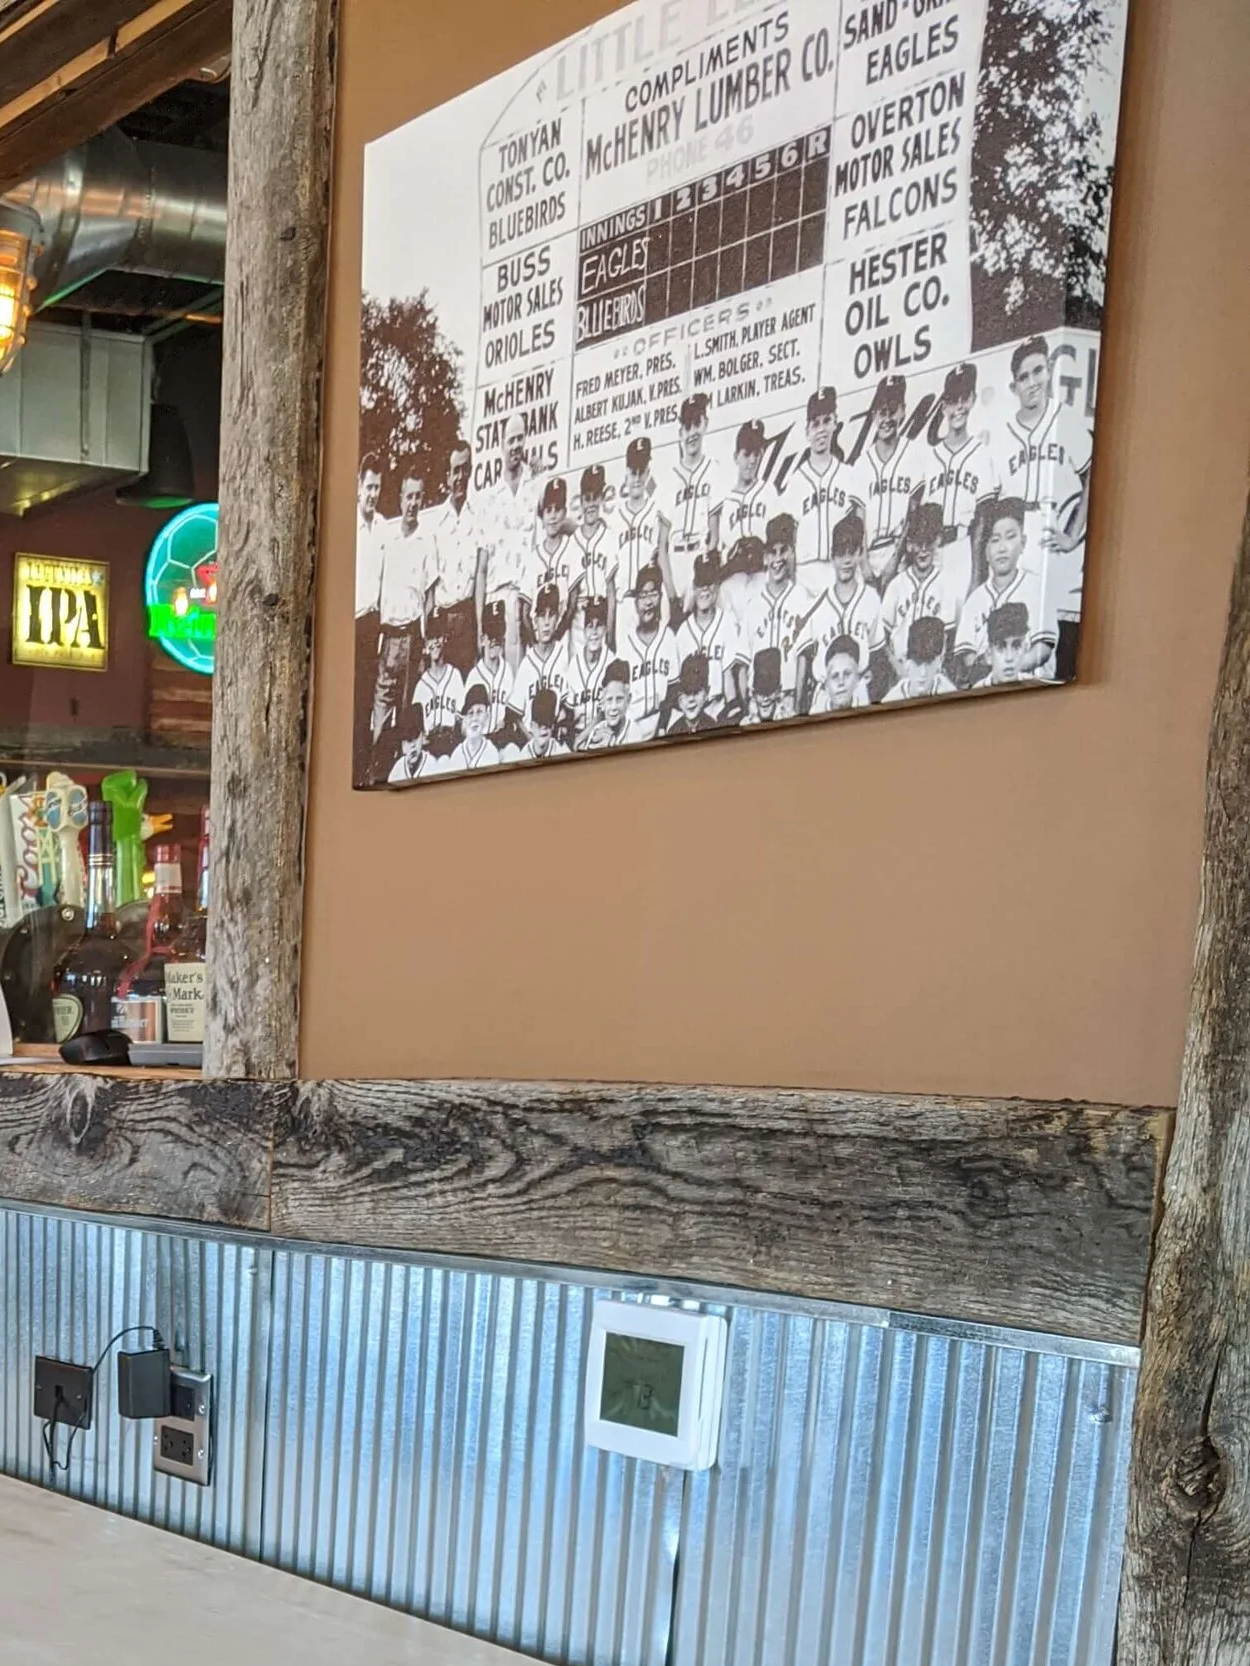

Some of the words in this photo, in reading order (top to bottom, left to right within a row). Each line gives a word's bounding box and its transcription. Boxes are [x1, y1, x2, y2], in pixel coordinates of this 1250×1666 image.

[843, 0, 898, 50] SAND
[866, 14, 959, 86] EAGLES
[625, 11, 789, 113] COMPLIMENTS
[585, 96, 686, 181] McHENRY
[695, 48, 792, 133] LUMBER
[801, 27, 835, 82] CO.
[851, 72, 967, 149] OVERTON
[499, 117, 562, 174] TONYAN
[646, 136, 709, 187] PHONE
[714, 115, 755, 152] 46
[834, 144, 894, 198] MOTOR
[901, 116, 962, 173] SALES
[486, 165, 536, 213] CONST.
[543, 151, 570, 187] CO.
[581, 203, 646, 248] INNINGS
[653, 198, 662, 219] 1
[676, 188, 691, 211] 2
[702, 176, 717, 201] 3
[726, 165, 745, 188] 4
[755, 154, 773, 178] 5
[781, 142, 798, 167] 6
[806, 131, 828, 158] R
[843, 167, 958, 241] FALCONS
[488, 190, 566, 250] BLUEBIRDS
[497, 245, 551, 293] BUSS
[581, 237, 650, 295] EAGLES
[849, 232, 948, 295] HESTER
[483, 292, 522, 332] MOTOR
[527, 276, 563, 317] SALES
[577, 284, 647, 343] BLUEBIRDS
[633, 302, 751, 356] OFFICERS
[741, 316, 777, 345] PLAYER
[781, 302, 816, 332] AGENT
[845, 293, 890, 336] OIL
[903, 275, 950, 318] CO.
[485, 319, 555, 369] ORIOLES
[693, 364, 716, 387] WM.
[768, 338, 800, 365] SECT.
[853, 323, 932, 379] OWLS
[484, 368, 555, 418] McHENRY
[575, 376, 601, 400] FRED
[646, 352, 676, 377] PRES.
[764, 366, 805, 393] TREAS.
[475, 417, 511, 453] STAT
[574, 399, 609, 424] ALBERT
[803, 487, 846, 516] EAGLES
[928, 469, 979, 495] EAGLES
[26, 584, 106, 650] IPA
[632, 658, 670, 681] EAGLES
